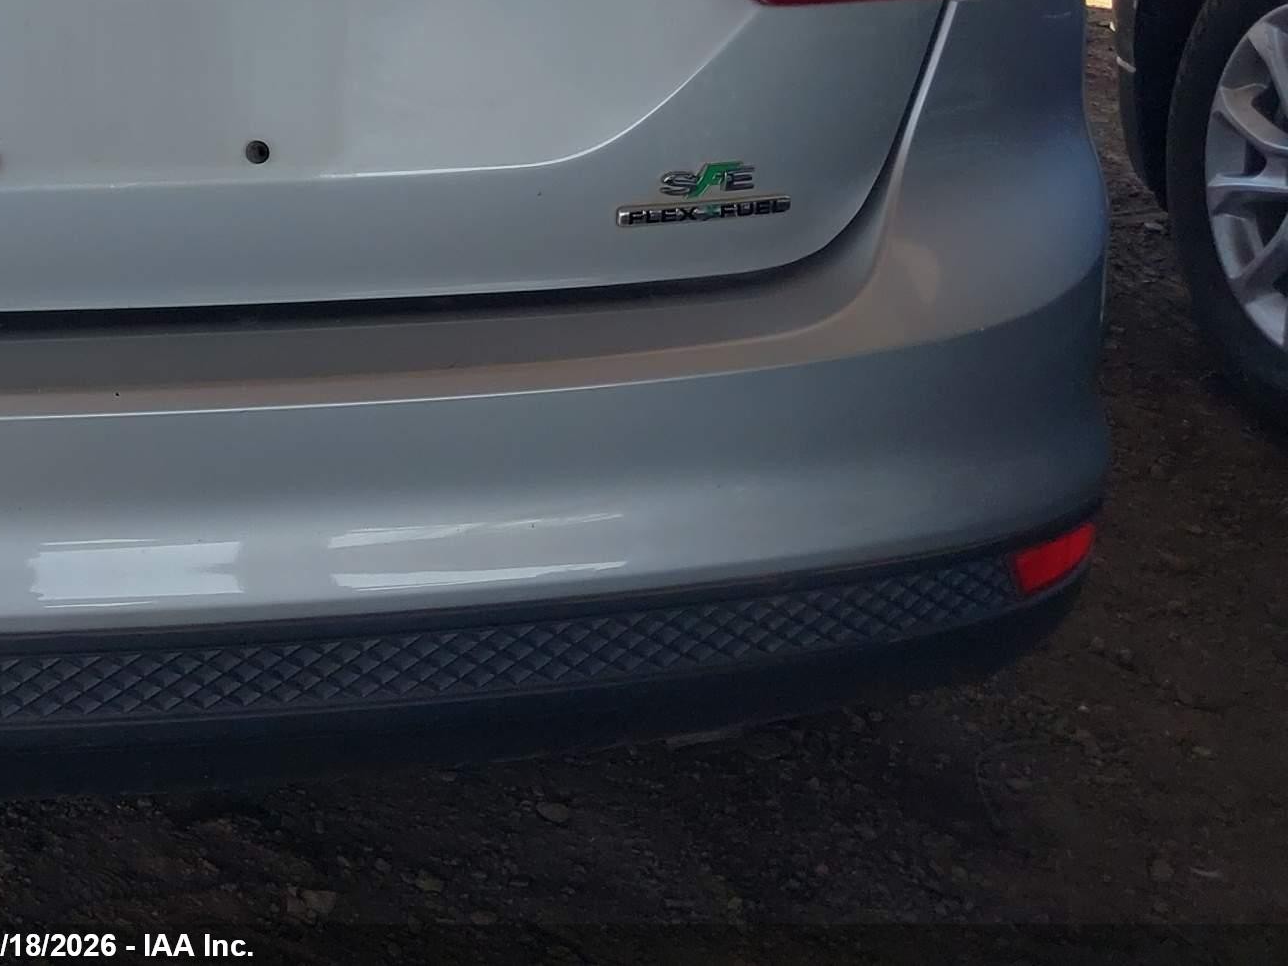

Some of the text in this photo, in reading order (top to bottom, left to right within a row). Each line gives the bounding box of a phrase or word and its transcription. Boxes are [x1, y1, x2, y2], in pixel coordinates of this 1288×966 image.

[660, 160, 755, 199] SFE
[628, 199, 791, 225] FLEX FUEL
